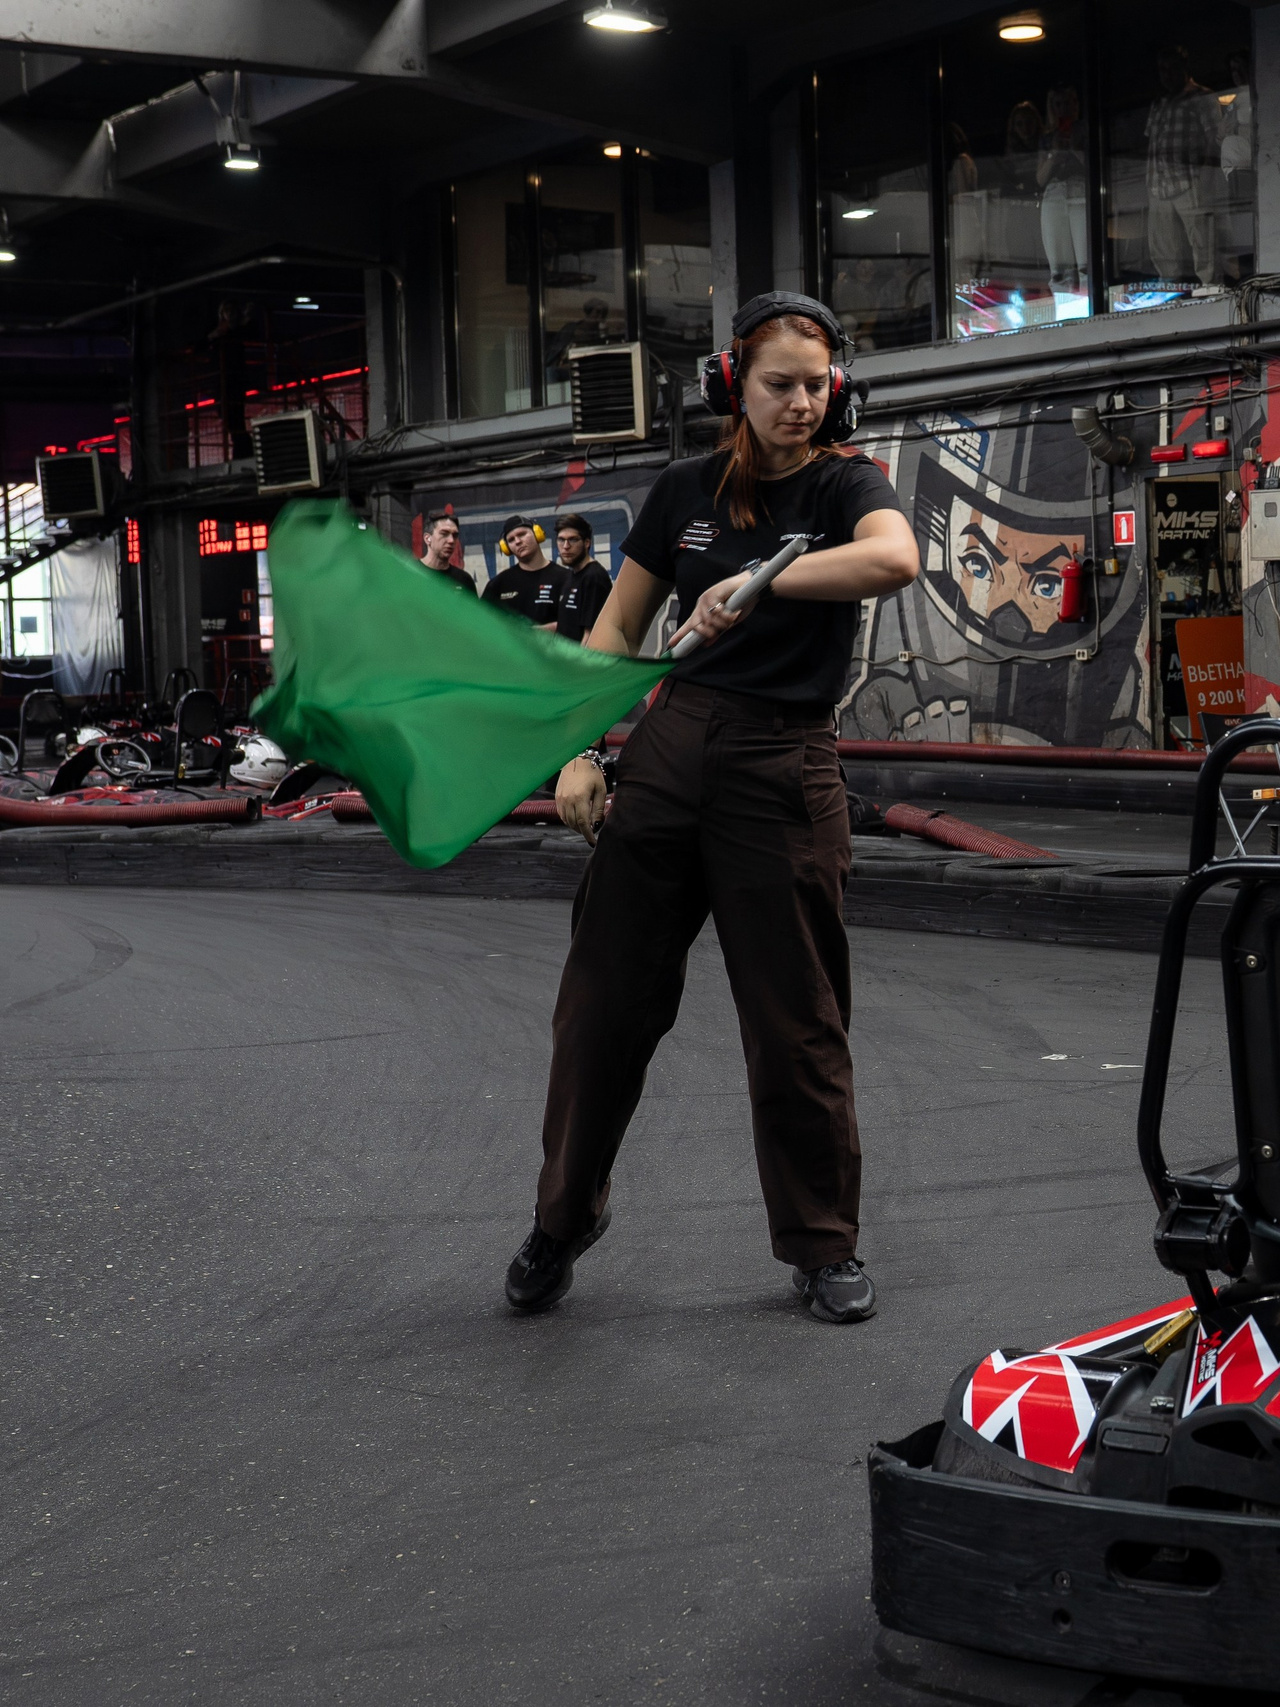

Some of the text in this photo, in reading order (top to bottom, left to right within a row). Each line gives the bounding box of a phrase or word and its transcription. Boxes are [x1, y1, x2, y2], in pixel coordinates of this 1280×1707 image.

[1156, 511, 1219, 529] MIKS
[1197, 692, 1206, 707] 9
[1209, 689, 1234, 706] 200
[1204, 1348, 1217, 1380] MIKS
